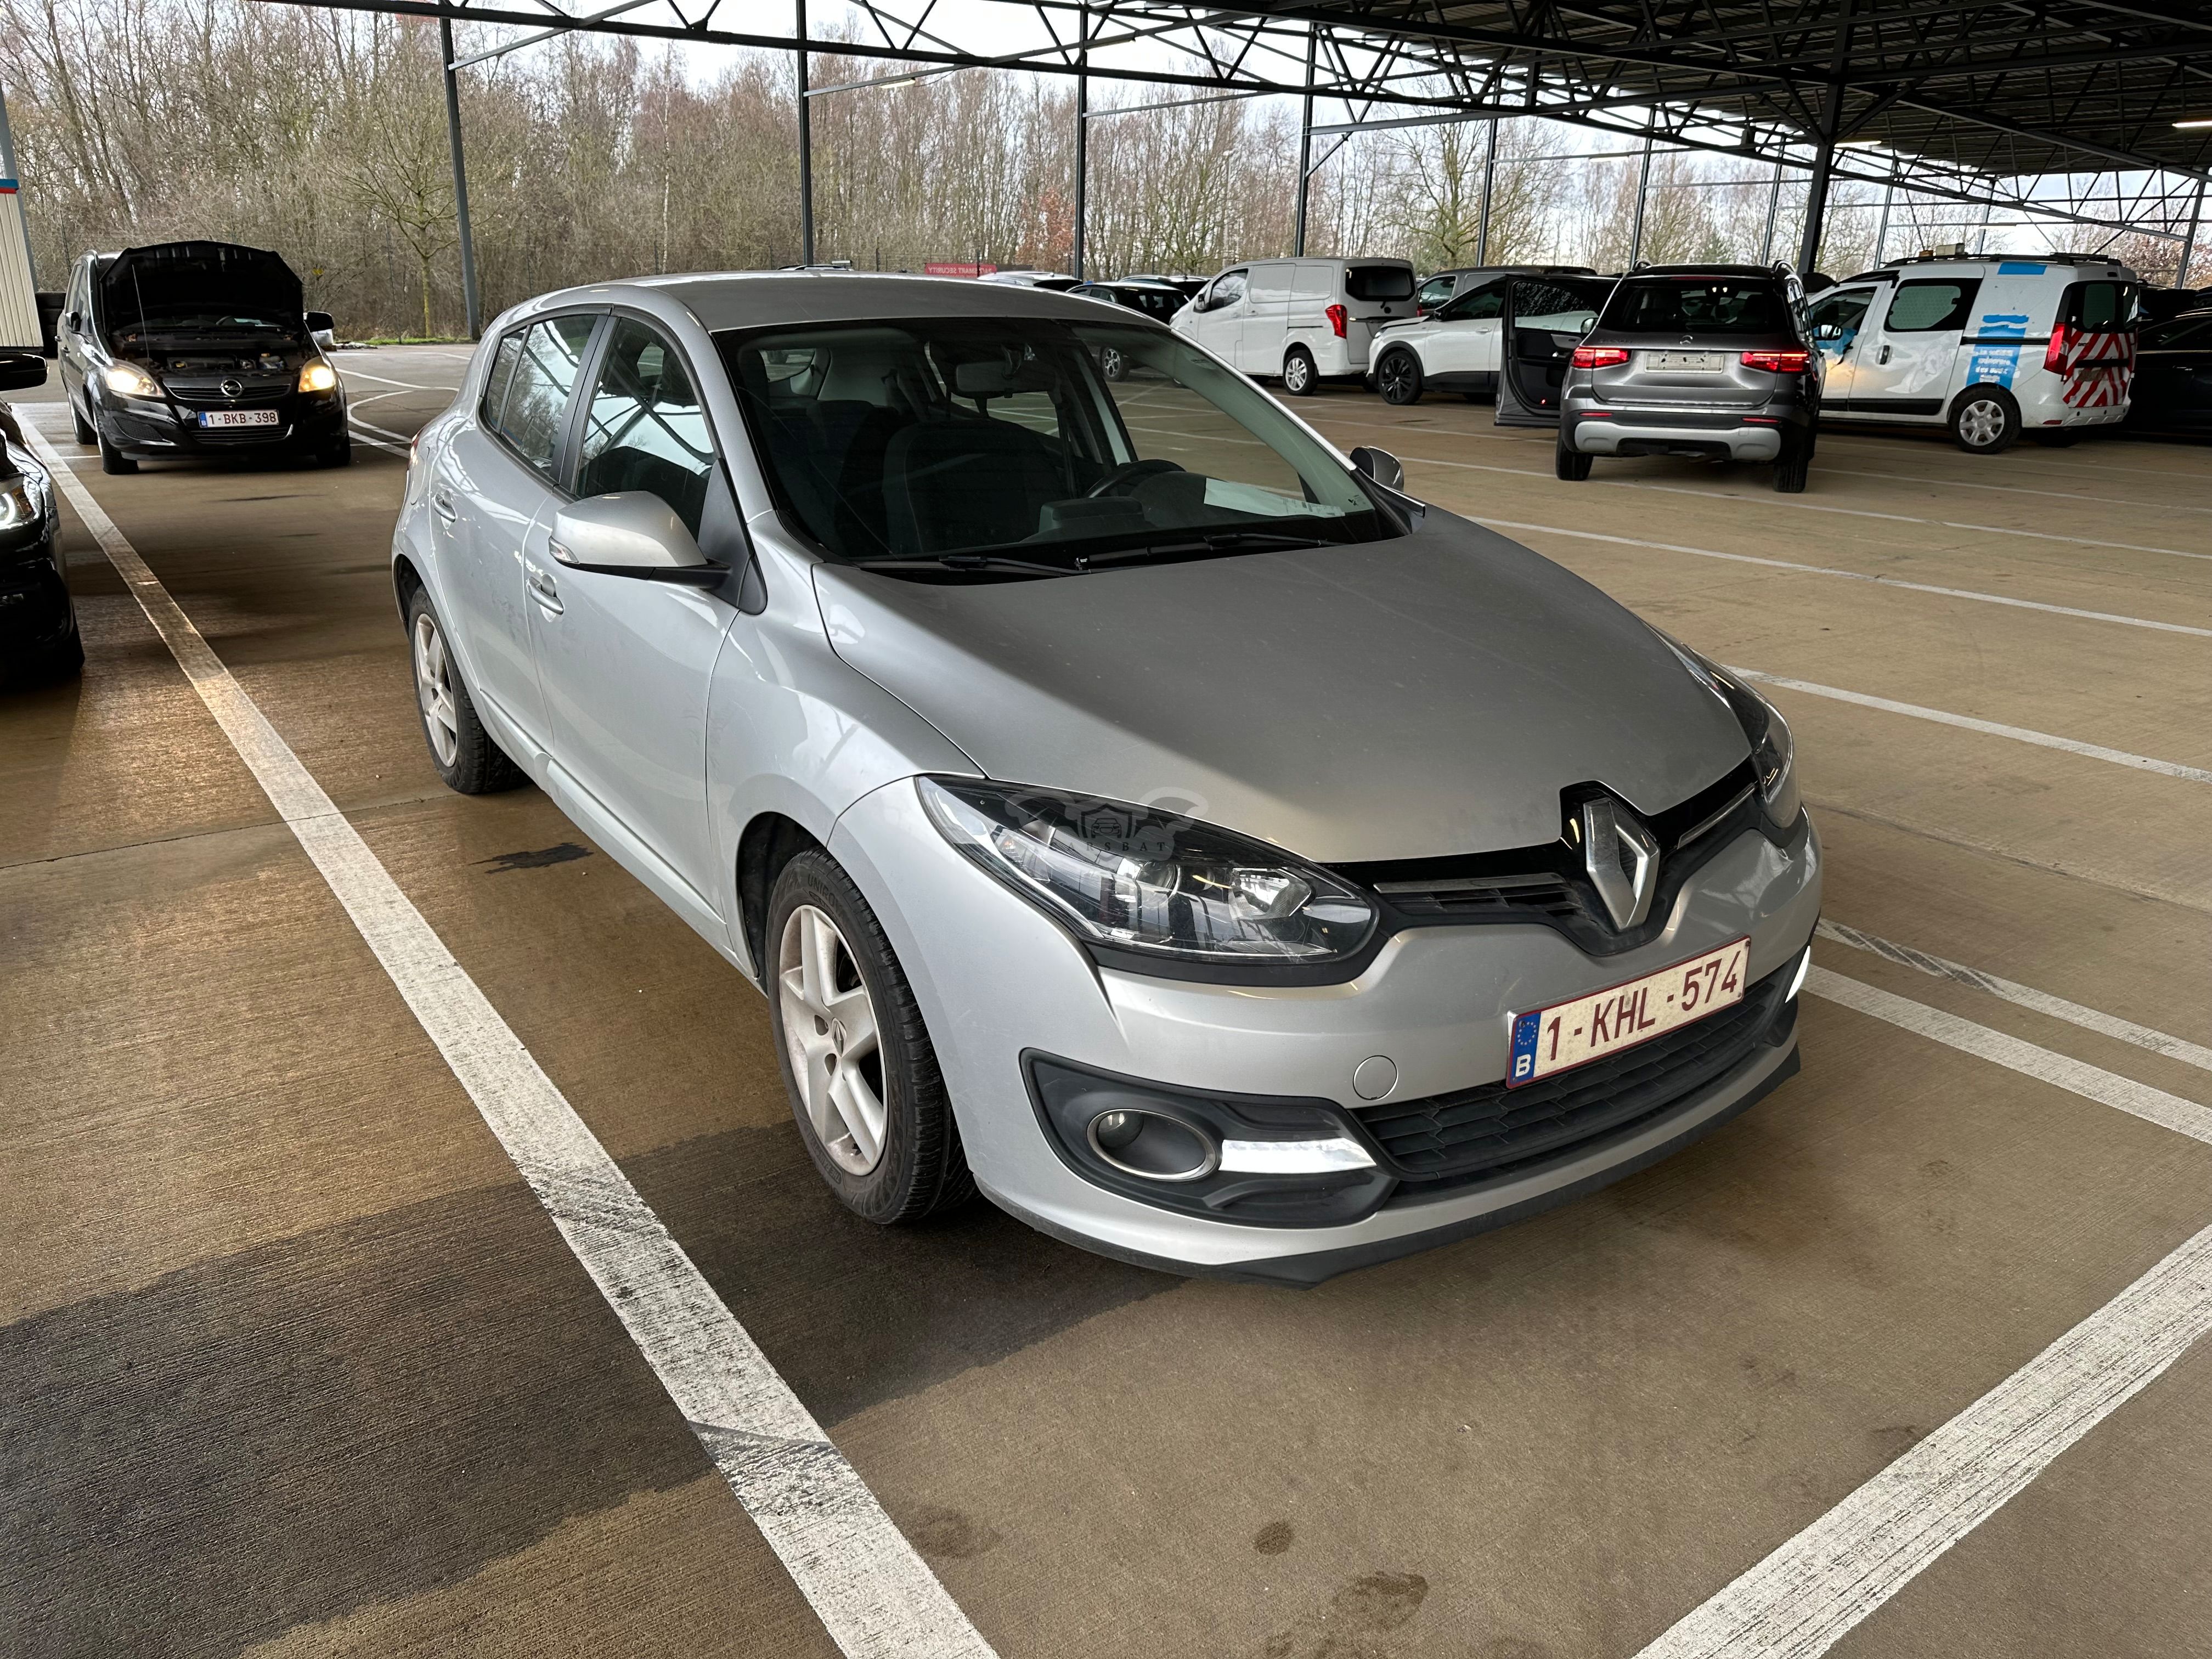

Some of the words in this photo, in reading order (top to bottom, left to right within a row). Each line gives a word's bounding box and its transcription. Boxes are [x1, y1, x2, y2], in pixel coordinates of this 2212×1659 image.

[209, 413, 276, 425] 1-BKB-398
[1547, 951, 1741, 1061] 1-KHL-574
[1515, 1054, 1531, 1077] B
